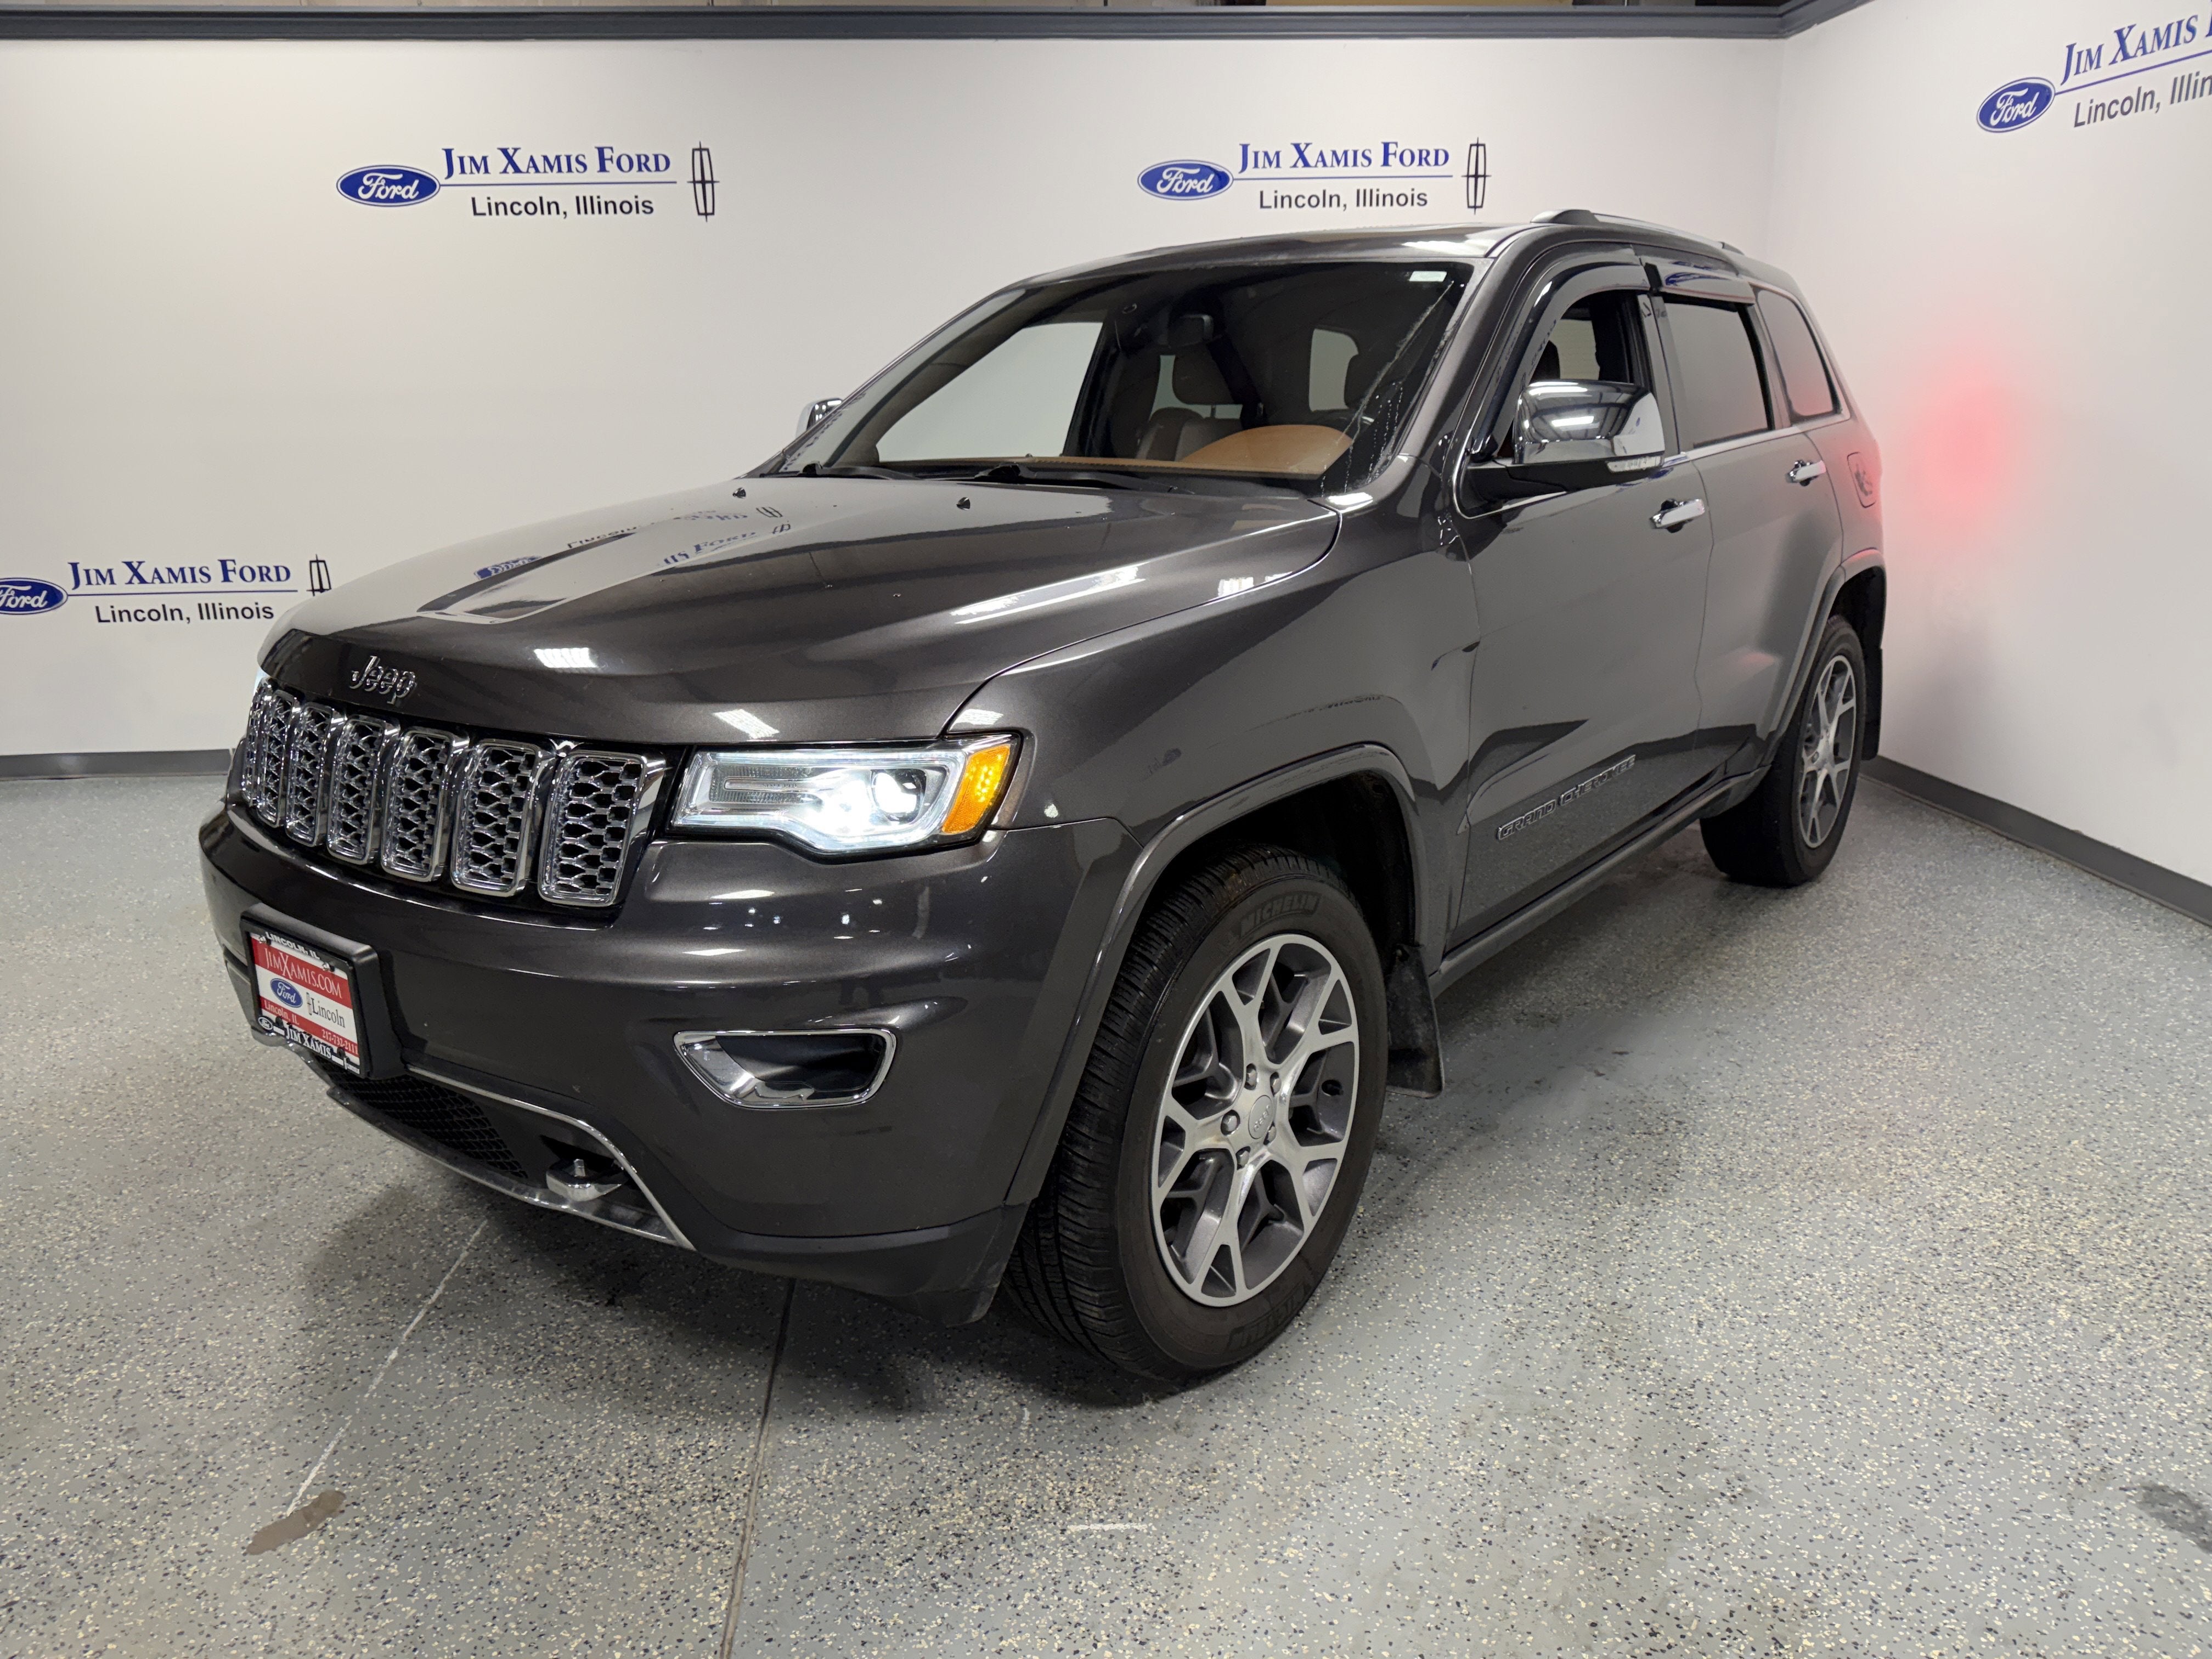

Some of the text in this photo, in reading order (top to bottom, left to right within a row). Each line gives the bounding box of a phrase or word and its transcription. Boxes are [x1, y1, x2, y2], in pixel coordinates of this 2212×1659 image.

[2061, 42, 2104, 86] JIM
[2108, 14, 2198, 66] XAMIS
[1989, 87, 2040, 126] Ford
[2074, 86, 2161, 128] Lincoln,
[441, 146, 671, 180] JIM XAMIS FORD
[1238, 142, 1449, 174] JIM XAMIS FORD
[358, 172, 419, 201] Ford
[1155, 167, 1214, 194] Ford
[471, 195, 654, 219] Lincoln, Illinois
[1260, 188, 1428, 211] Lincoln, Illinois
[67, 559, 291, 591] JIM XAMIS FORD
[0, 584, 48, 608] Ford
[95, 602, 274, 624] Lincoln, Illinois
[349, 656, 417, 705] Jeep
[1498, 799, 1557, 840] GRAND
[310, 950, 320, 960] IL
[264, 947, 343, 999] JIMXAMIS.COM
[276, 981, 297, 1004] Ford
[292, 1013, 300, 1025] IL
[311, 997, 346, 1029] Lincoln
[285, 1024, 332, 1059] JIM XAMIS
